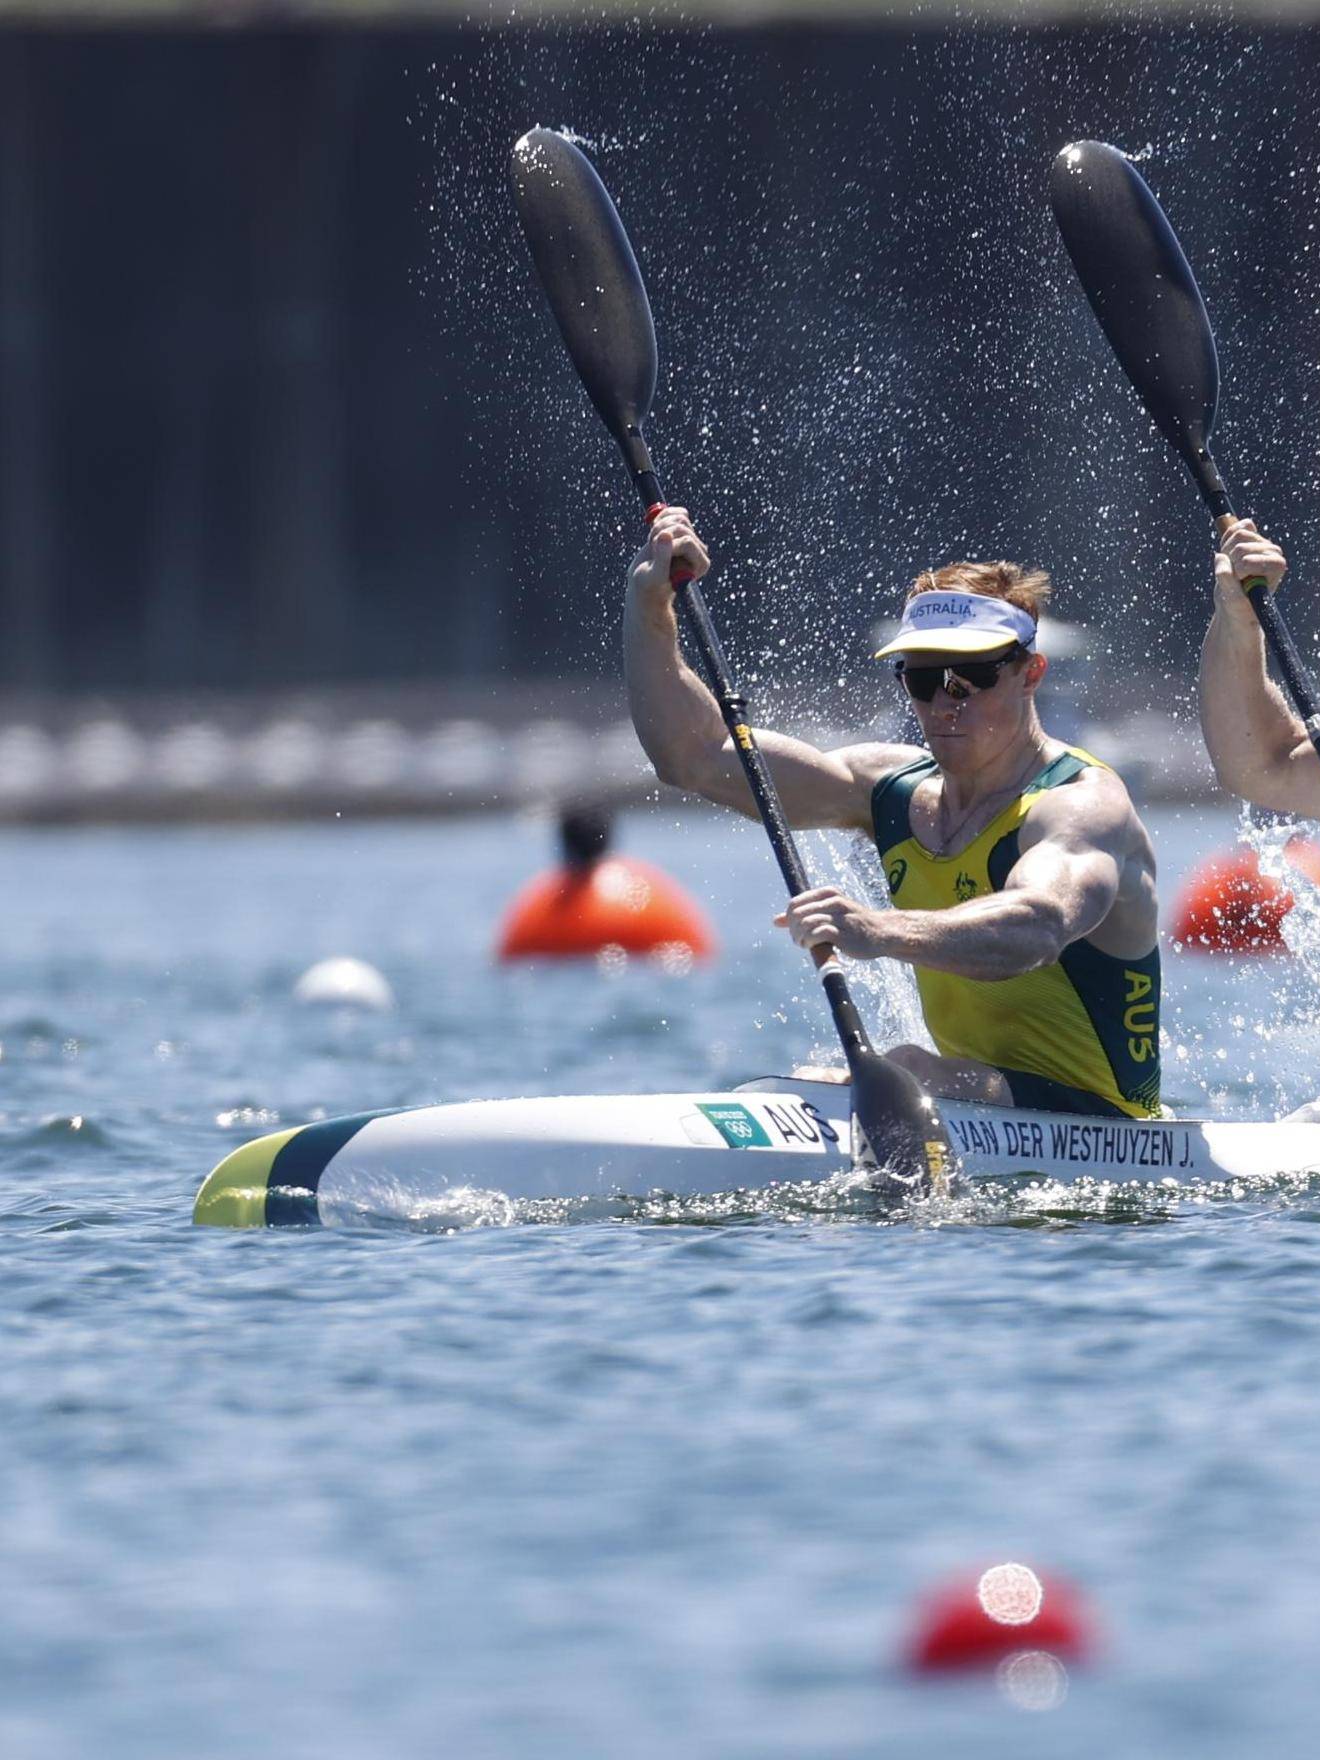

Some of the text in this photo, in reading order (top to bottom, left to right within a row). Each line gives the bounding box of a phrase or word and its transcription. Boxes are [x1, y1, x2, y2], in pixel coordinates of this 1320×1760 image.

[1122, 968, 1157, 1064] AUS
[762, 1101, 840, 1144] AUS
[948, 1119, 1194, 1168] VAN DER WESTHUYZEN J.
